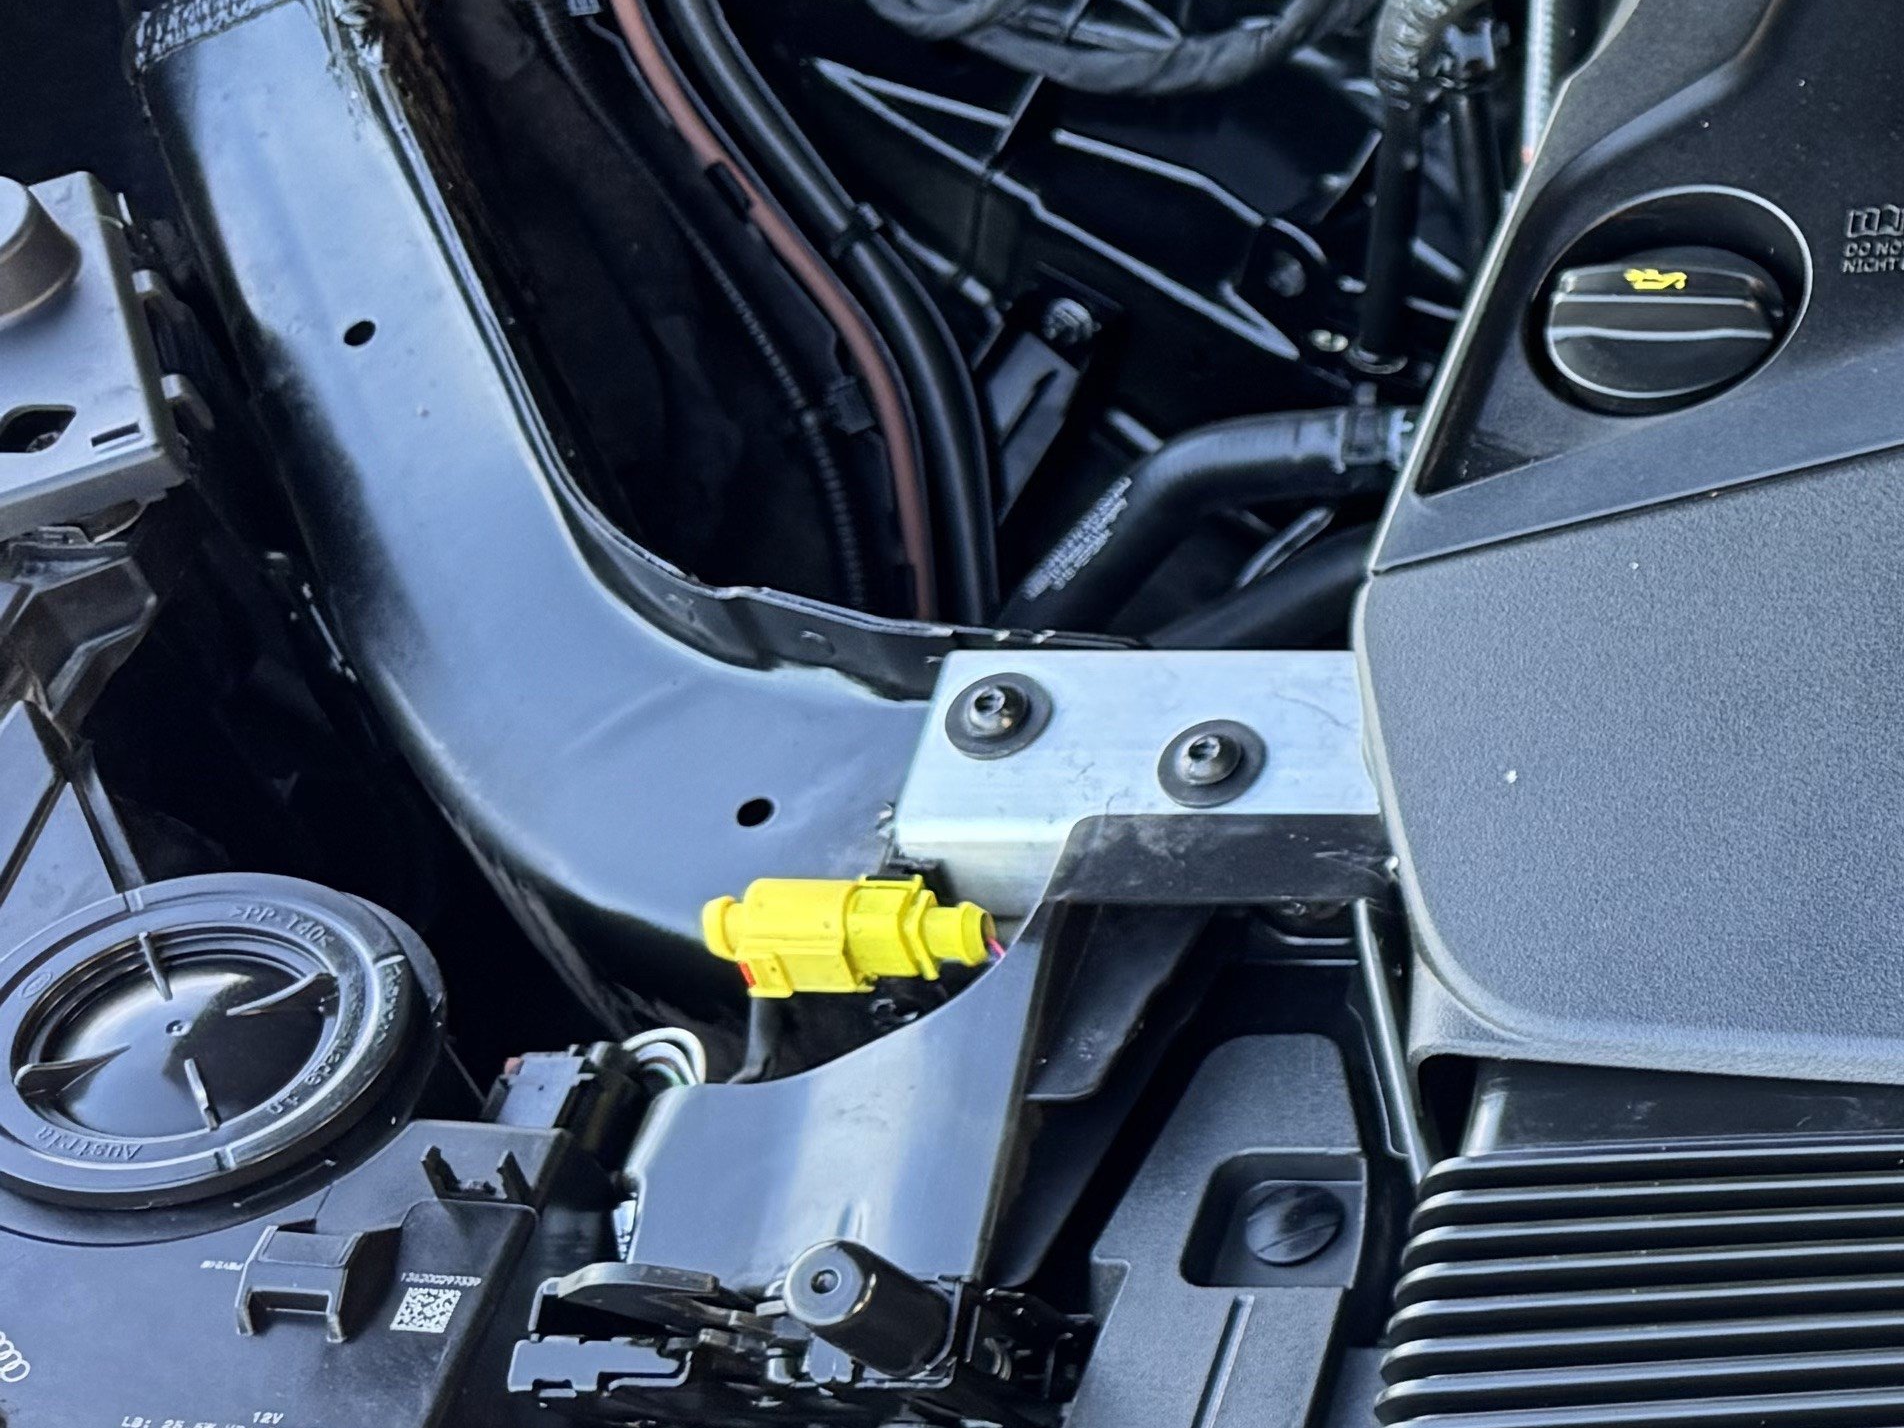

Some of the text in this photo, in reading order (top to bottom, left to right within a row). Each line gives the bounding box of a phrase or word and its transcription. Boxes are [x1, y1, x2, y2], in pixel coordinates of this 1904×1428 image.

[1845, 241, 1871, 257] DO
[1843, 256, 1899, 273] NICHT
[252, 1411, 284, 1425] 12V
